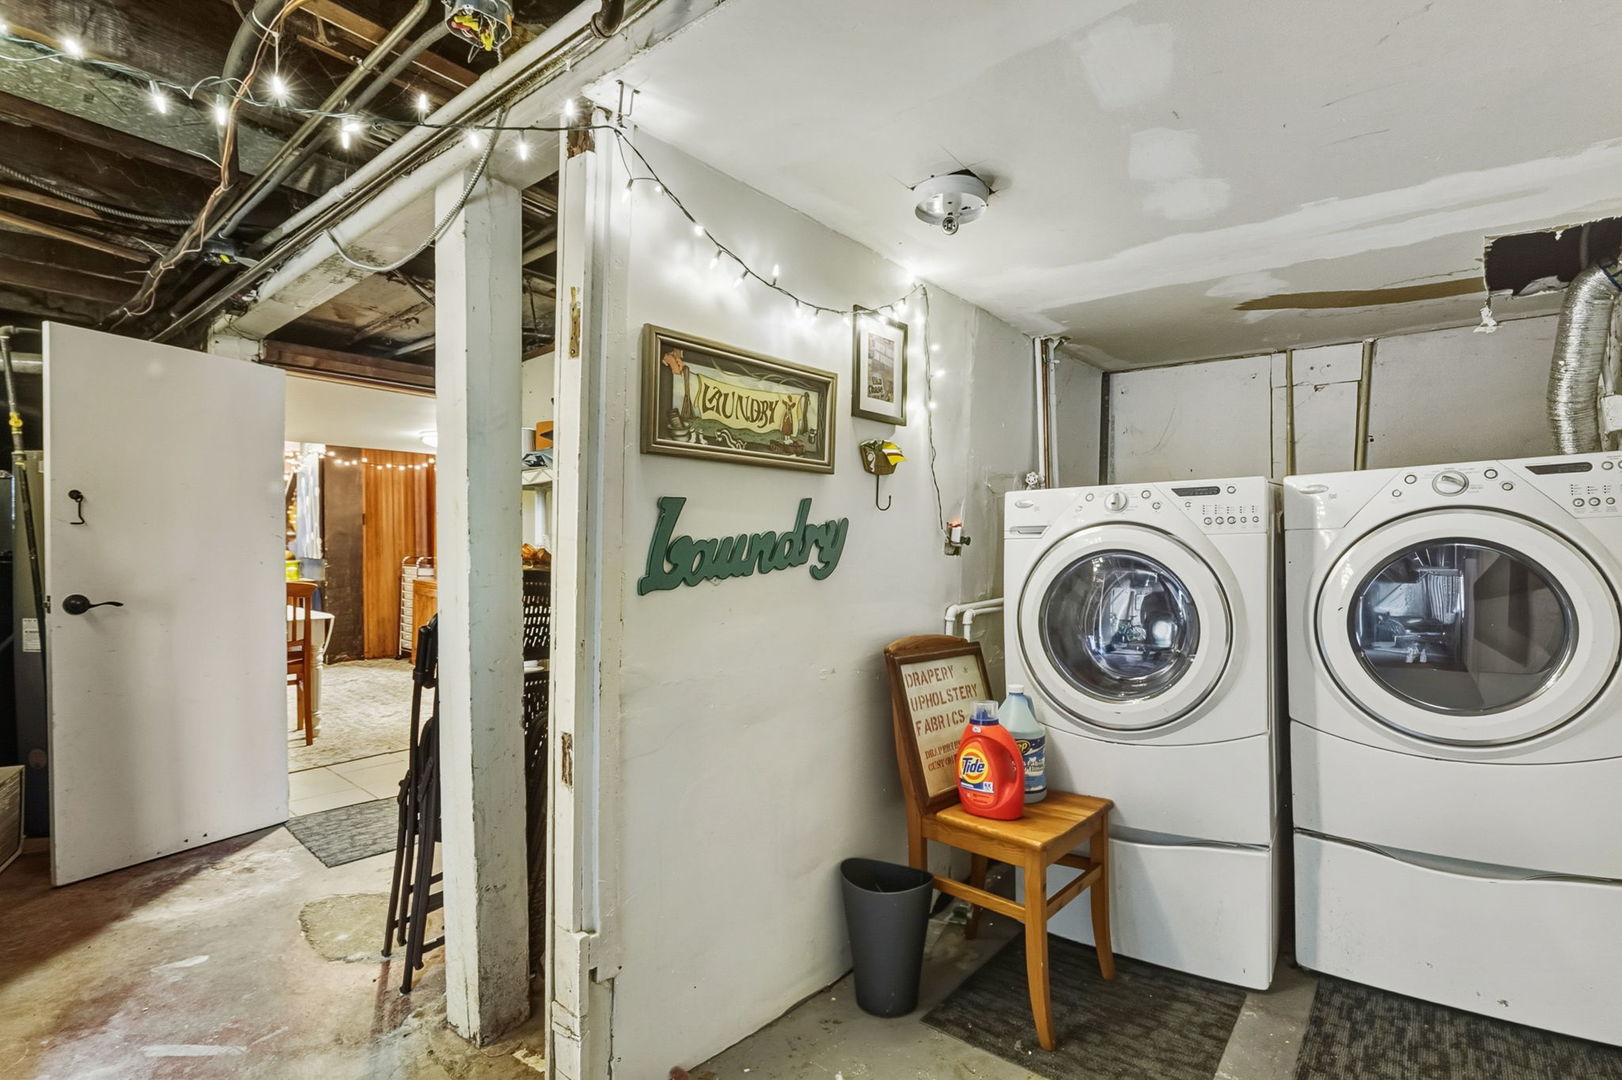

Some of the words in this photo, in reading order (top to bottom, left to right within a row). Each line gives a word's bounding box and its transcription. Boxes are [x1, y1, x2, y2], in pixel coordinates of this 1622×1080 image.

[702, 382, 779, 428] LAUNDRY
[637, 496, 849, 596] Laundry
[905, 665, 954, 688] DRAPERY
[909, 683, 979, 712] UPHOLSTERY
[915, 709, 966, 736] FABRICS
[962, 757, 985, 775] Tide
